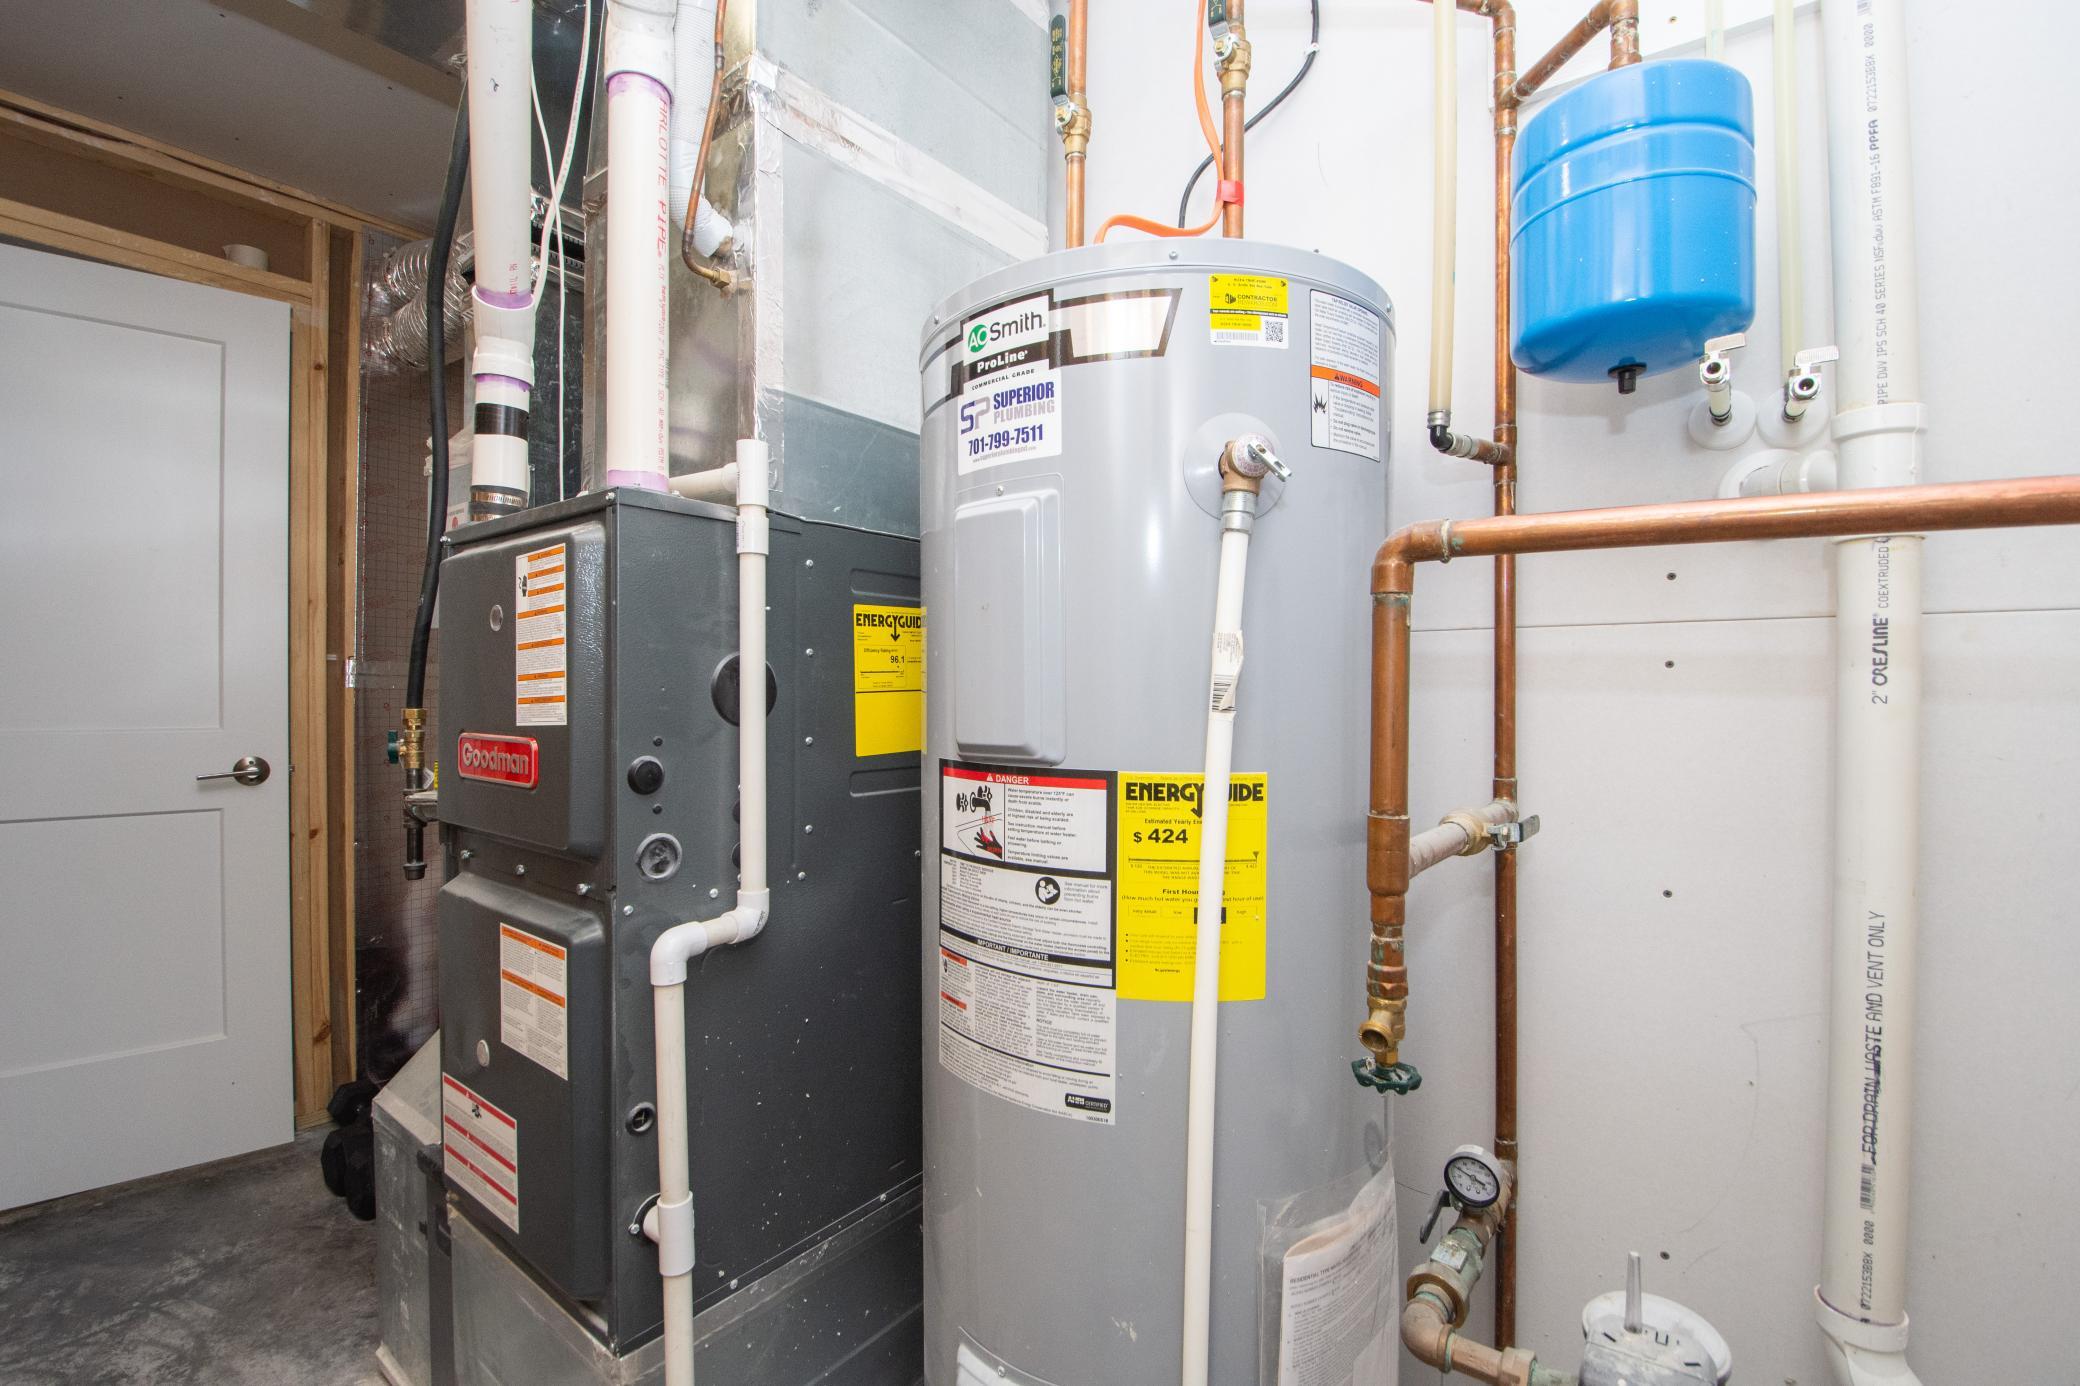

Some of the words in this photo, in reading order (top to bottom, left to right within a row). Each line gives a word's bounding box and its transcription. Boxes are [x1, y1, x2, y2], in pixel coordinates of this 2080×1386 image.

[658, 100, 668, 186] ARLOTTE
[1868, 119, 1880, 151] PPFA
[1870, 154, 1882, 193] F891-16
[1871, 197, 1883, 221] ASTM
[657, 200, 667, 253] PIPE
[1874, 264, 1886, 299] SERIES
[1875, 302, 1886, 315] 40
[989, 311, 1043, 342] Smith
[1875, 319, 1887, 337] SCH
[977, 350, 1024, 373] ProLine
[1876, 339, 1887, 356] IPS
[971, 374, 1009, 391] COMMERCIAL
[1011, 368, 1035, 379] GRADE
[1876, 360, 1887, 379] DWV
[993, 381, 1055, 410] SUPERIOR
[1876, 382, 1888, 405] PIPE
[993, 399, 1055, 424] PLUMBING
[968, 423, 1044, 456] 701-799-7511
[1878, 546, 1889, 608] COEXTRUDED
[856, 613, 922, 629] ENERGYGUID
[890, 655, 905, 663] 96.1
[1871, 617, 1888, 686] CRESLINE
[1871, 690, 1888, 704] 2"
[462, 742, 529, 775] Goodman
[996, 775, 1029, 785] DANGER
[1133, 831, 1142, 844] $
[1148, 828, 1189, 843] 424
[1867, 911, 1885, 948] ONLY
[977, 939, 1006, 951] IMPORTANT
[1010, 948, 1049, 960] IMPORTANTE
[1867, 952, 1884, 988] VENT
[1866, 993, 1883, 1022] AND
[1864, 1025, 1882, 1071] WASTE
[1863, 1078, 1879, 1122] DRAIN
